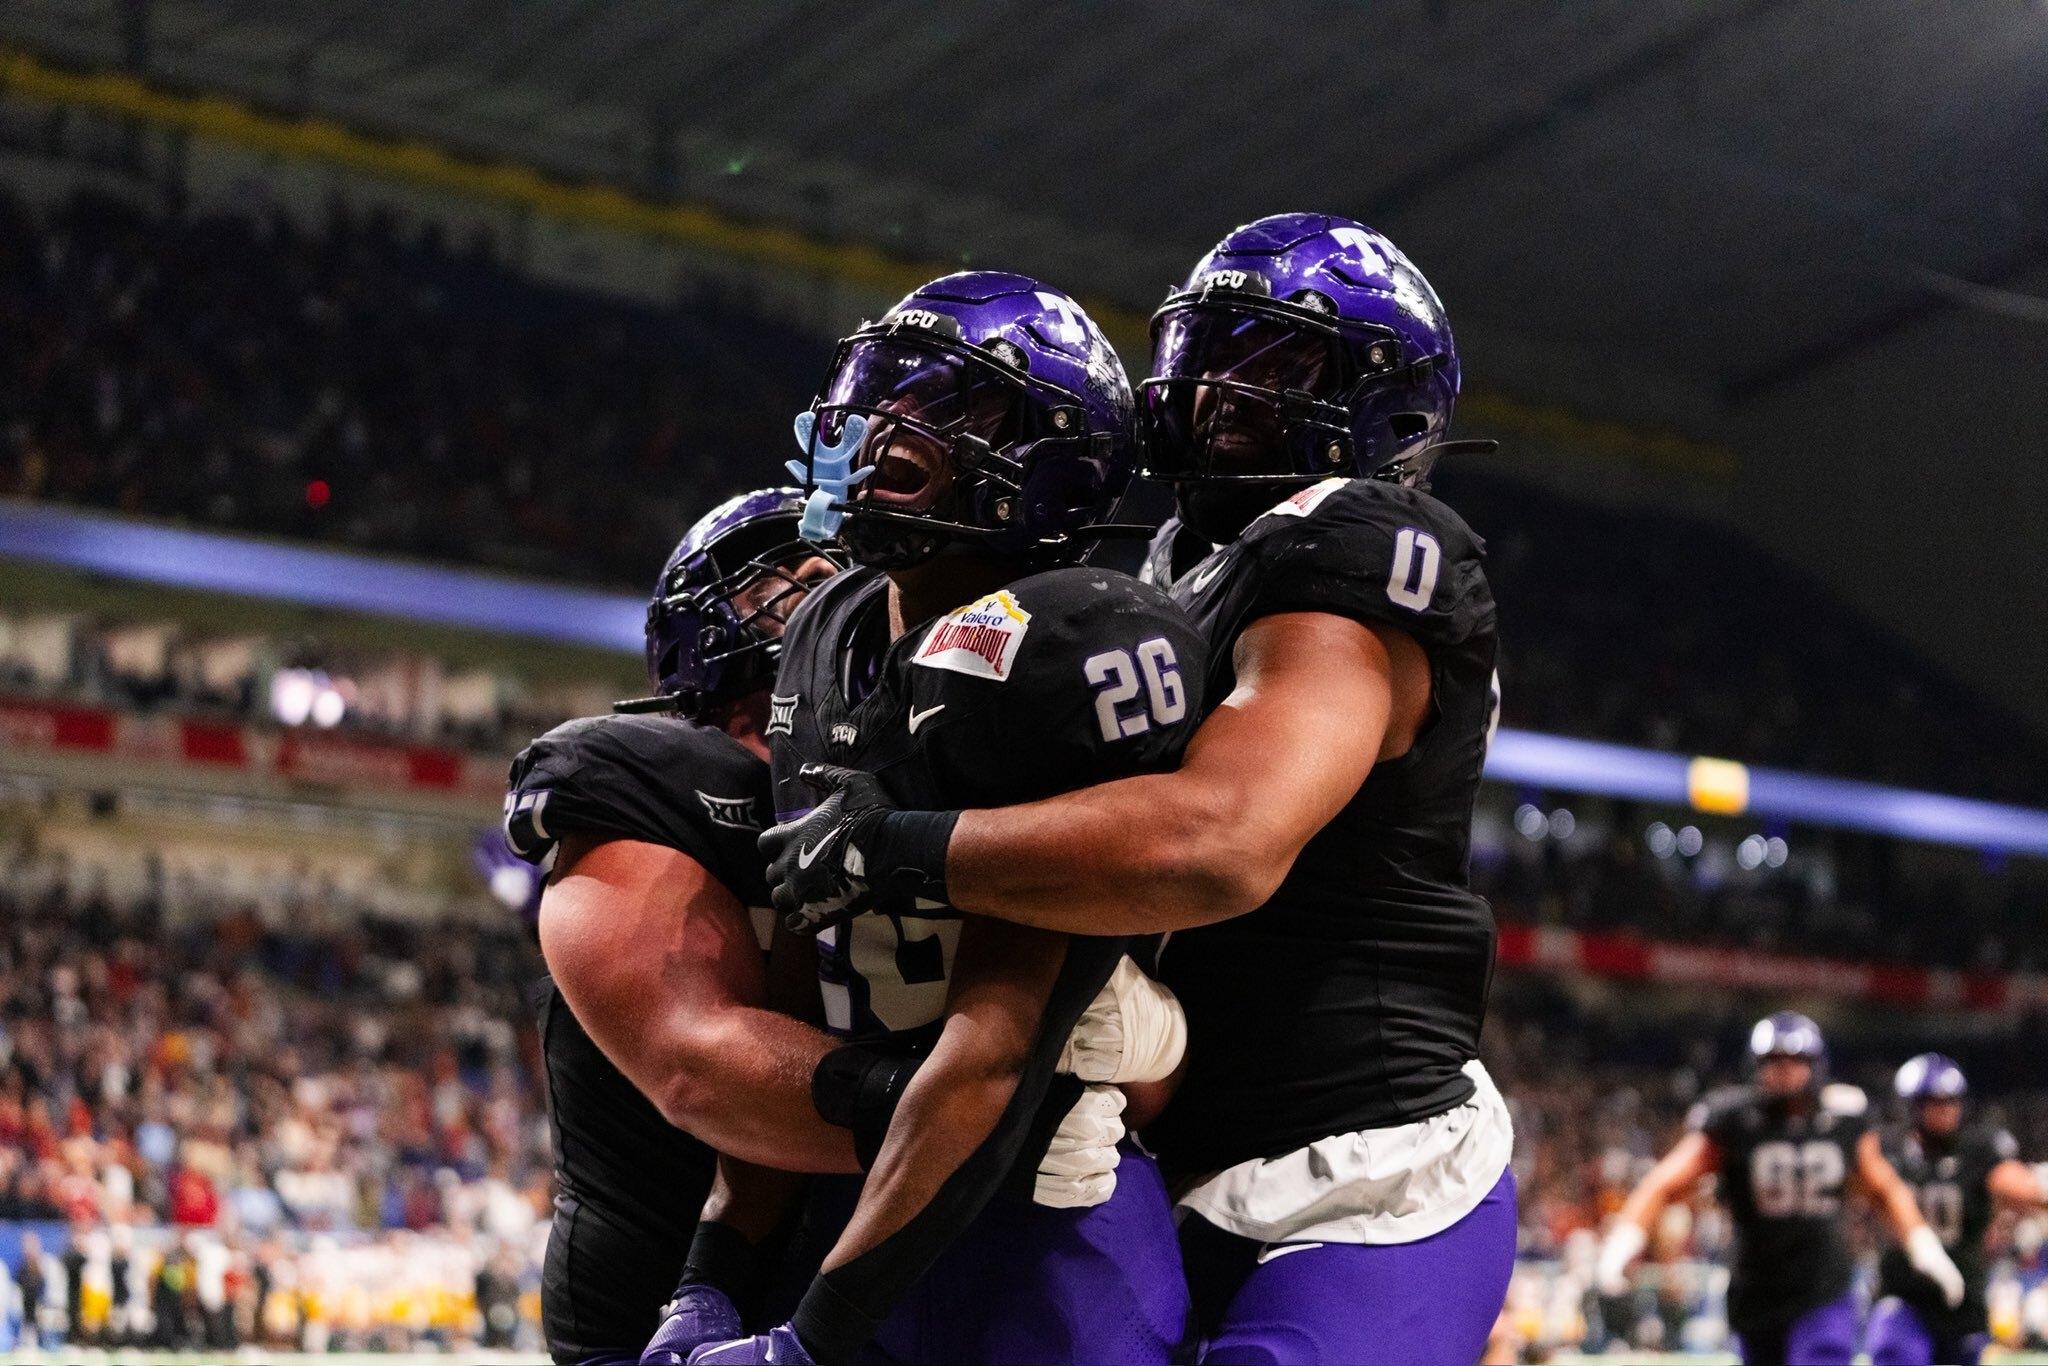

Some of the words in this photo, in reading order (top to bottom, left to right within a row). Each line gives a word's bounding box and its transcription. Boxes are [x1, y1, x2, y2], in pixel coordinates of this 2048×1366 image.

[1203, 269, 1248, 291] TCU
[895, 309, 939, 329] TCU
[1385, 526, 1442, 614] 0
[960, 612, 1004, 627] Valero
[1082, 635, 1187, 744] 26
[831, 725, 859, 747] TCU
